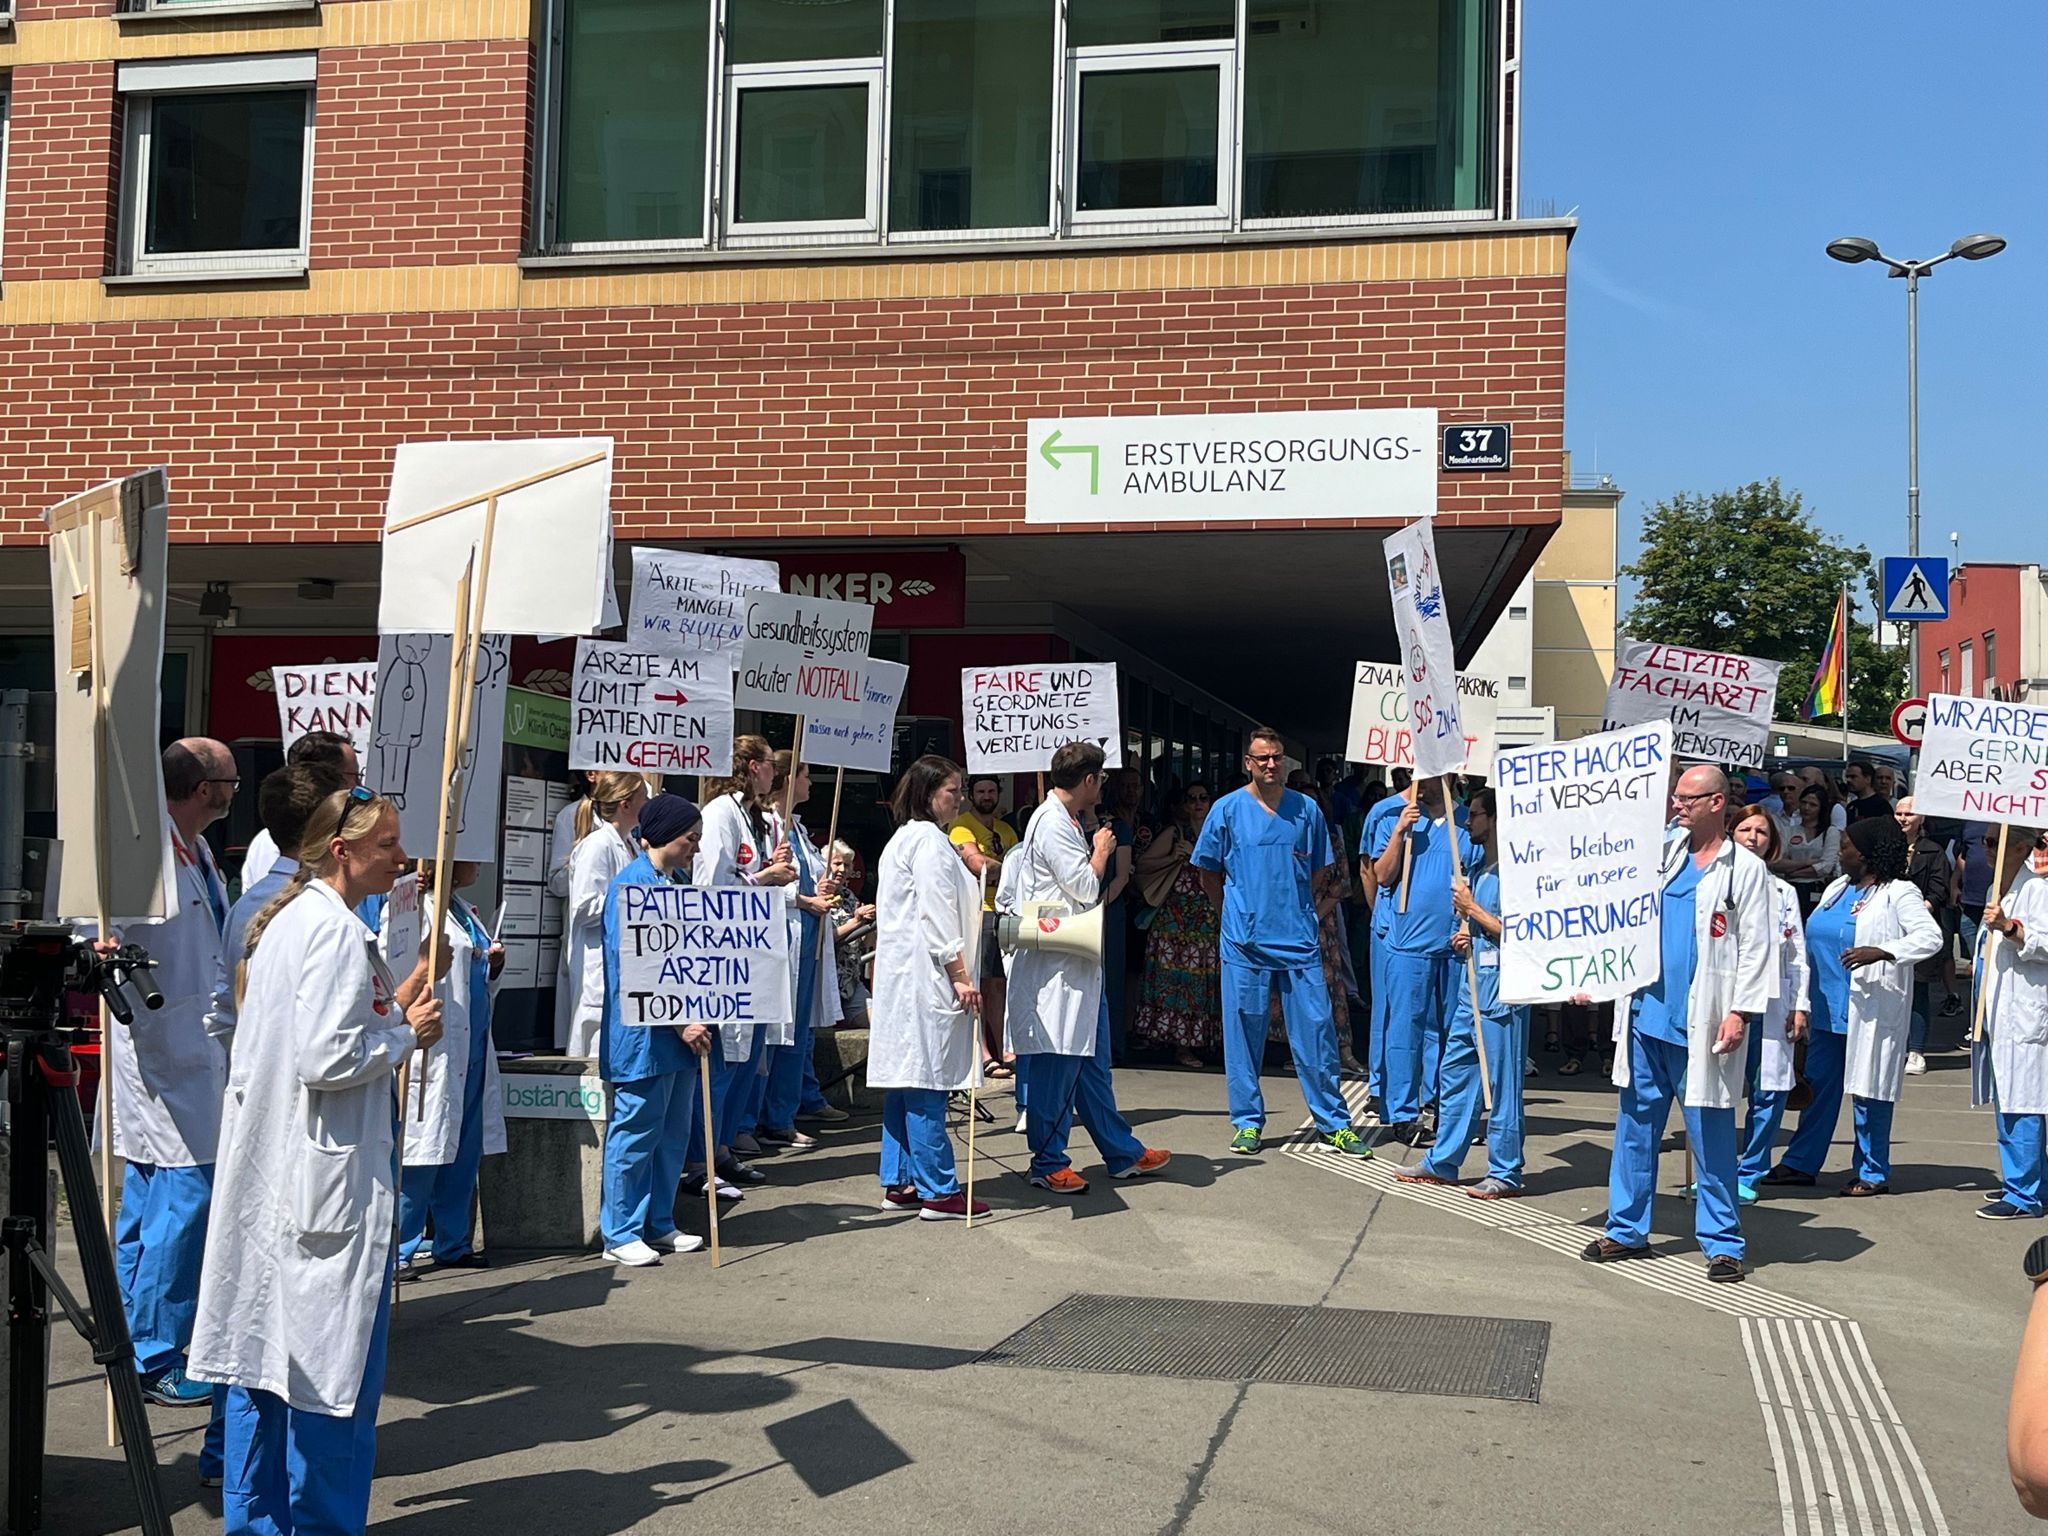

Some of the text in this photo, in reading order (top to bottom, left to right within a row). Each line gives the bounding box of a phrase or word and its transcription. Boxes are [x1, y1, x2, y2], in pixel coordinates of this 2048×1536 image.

[1125, 436, 1422, 466] ERSTVERSORGUNGS-
[1459, 429, 1493, 452] 37
[1123, 468, 1286, 494] AMBULANZ
[648, 561, 697, 592] ÄRZTE
[790, 573, 893, 604] NKER
[679, 618, 743, 642] BLUTEN
[747, 603, 868, 656] Gesundheitssystem
[582, 643, 699, 680] ÄRZTE AM
[1358, 665, 1393, 687] ZNA
[1644, 645, 1750, 682] LETZTER
[578, 680, 646, 706] LIMIT
[745, 662, 860, 702] akuter NOTFALL
[974, 669, 1092, 693] FAIRE UND
[1618, 667, 1767, 713] FACHARZT
[973, 691, 1091, 713] GEORDNETE
[1414, 694, 1432, 734] SOS
[1436, 703, 1459, 738] ZNA
[1670, 705, 1700, 727] IM
[1932, 696, 1974, 730] WIR
[577, 708, 706, 739] PATIENTEN
[595, 741, 712, 769] IN GEFAHR
[1498, 733, 1662, 787] PETER HACKER
[1969, 739, 2048, 765] GERN
[1931, 760, 2002, 785] ABER
[1510, 772, 1656, 818] hat VERSAGT
[1962, 790, 2046, 817] NICHT
[1509, 832, 1634, 864] Wir bleiben
[1536, 866, 1638, 899] für unsere
[625, 886, 771, 921] PATIENTIN
[1502, 888, 1661, 943] FORDERUNGEN
[658, 953, 750, 985] ÄRZTIN
[1541, 944, 1637, 991] STARK
